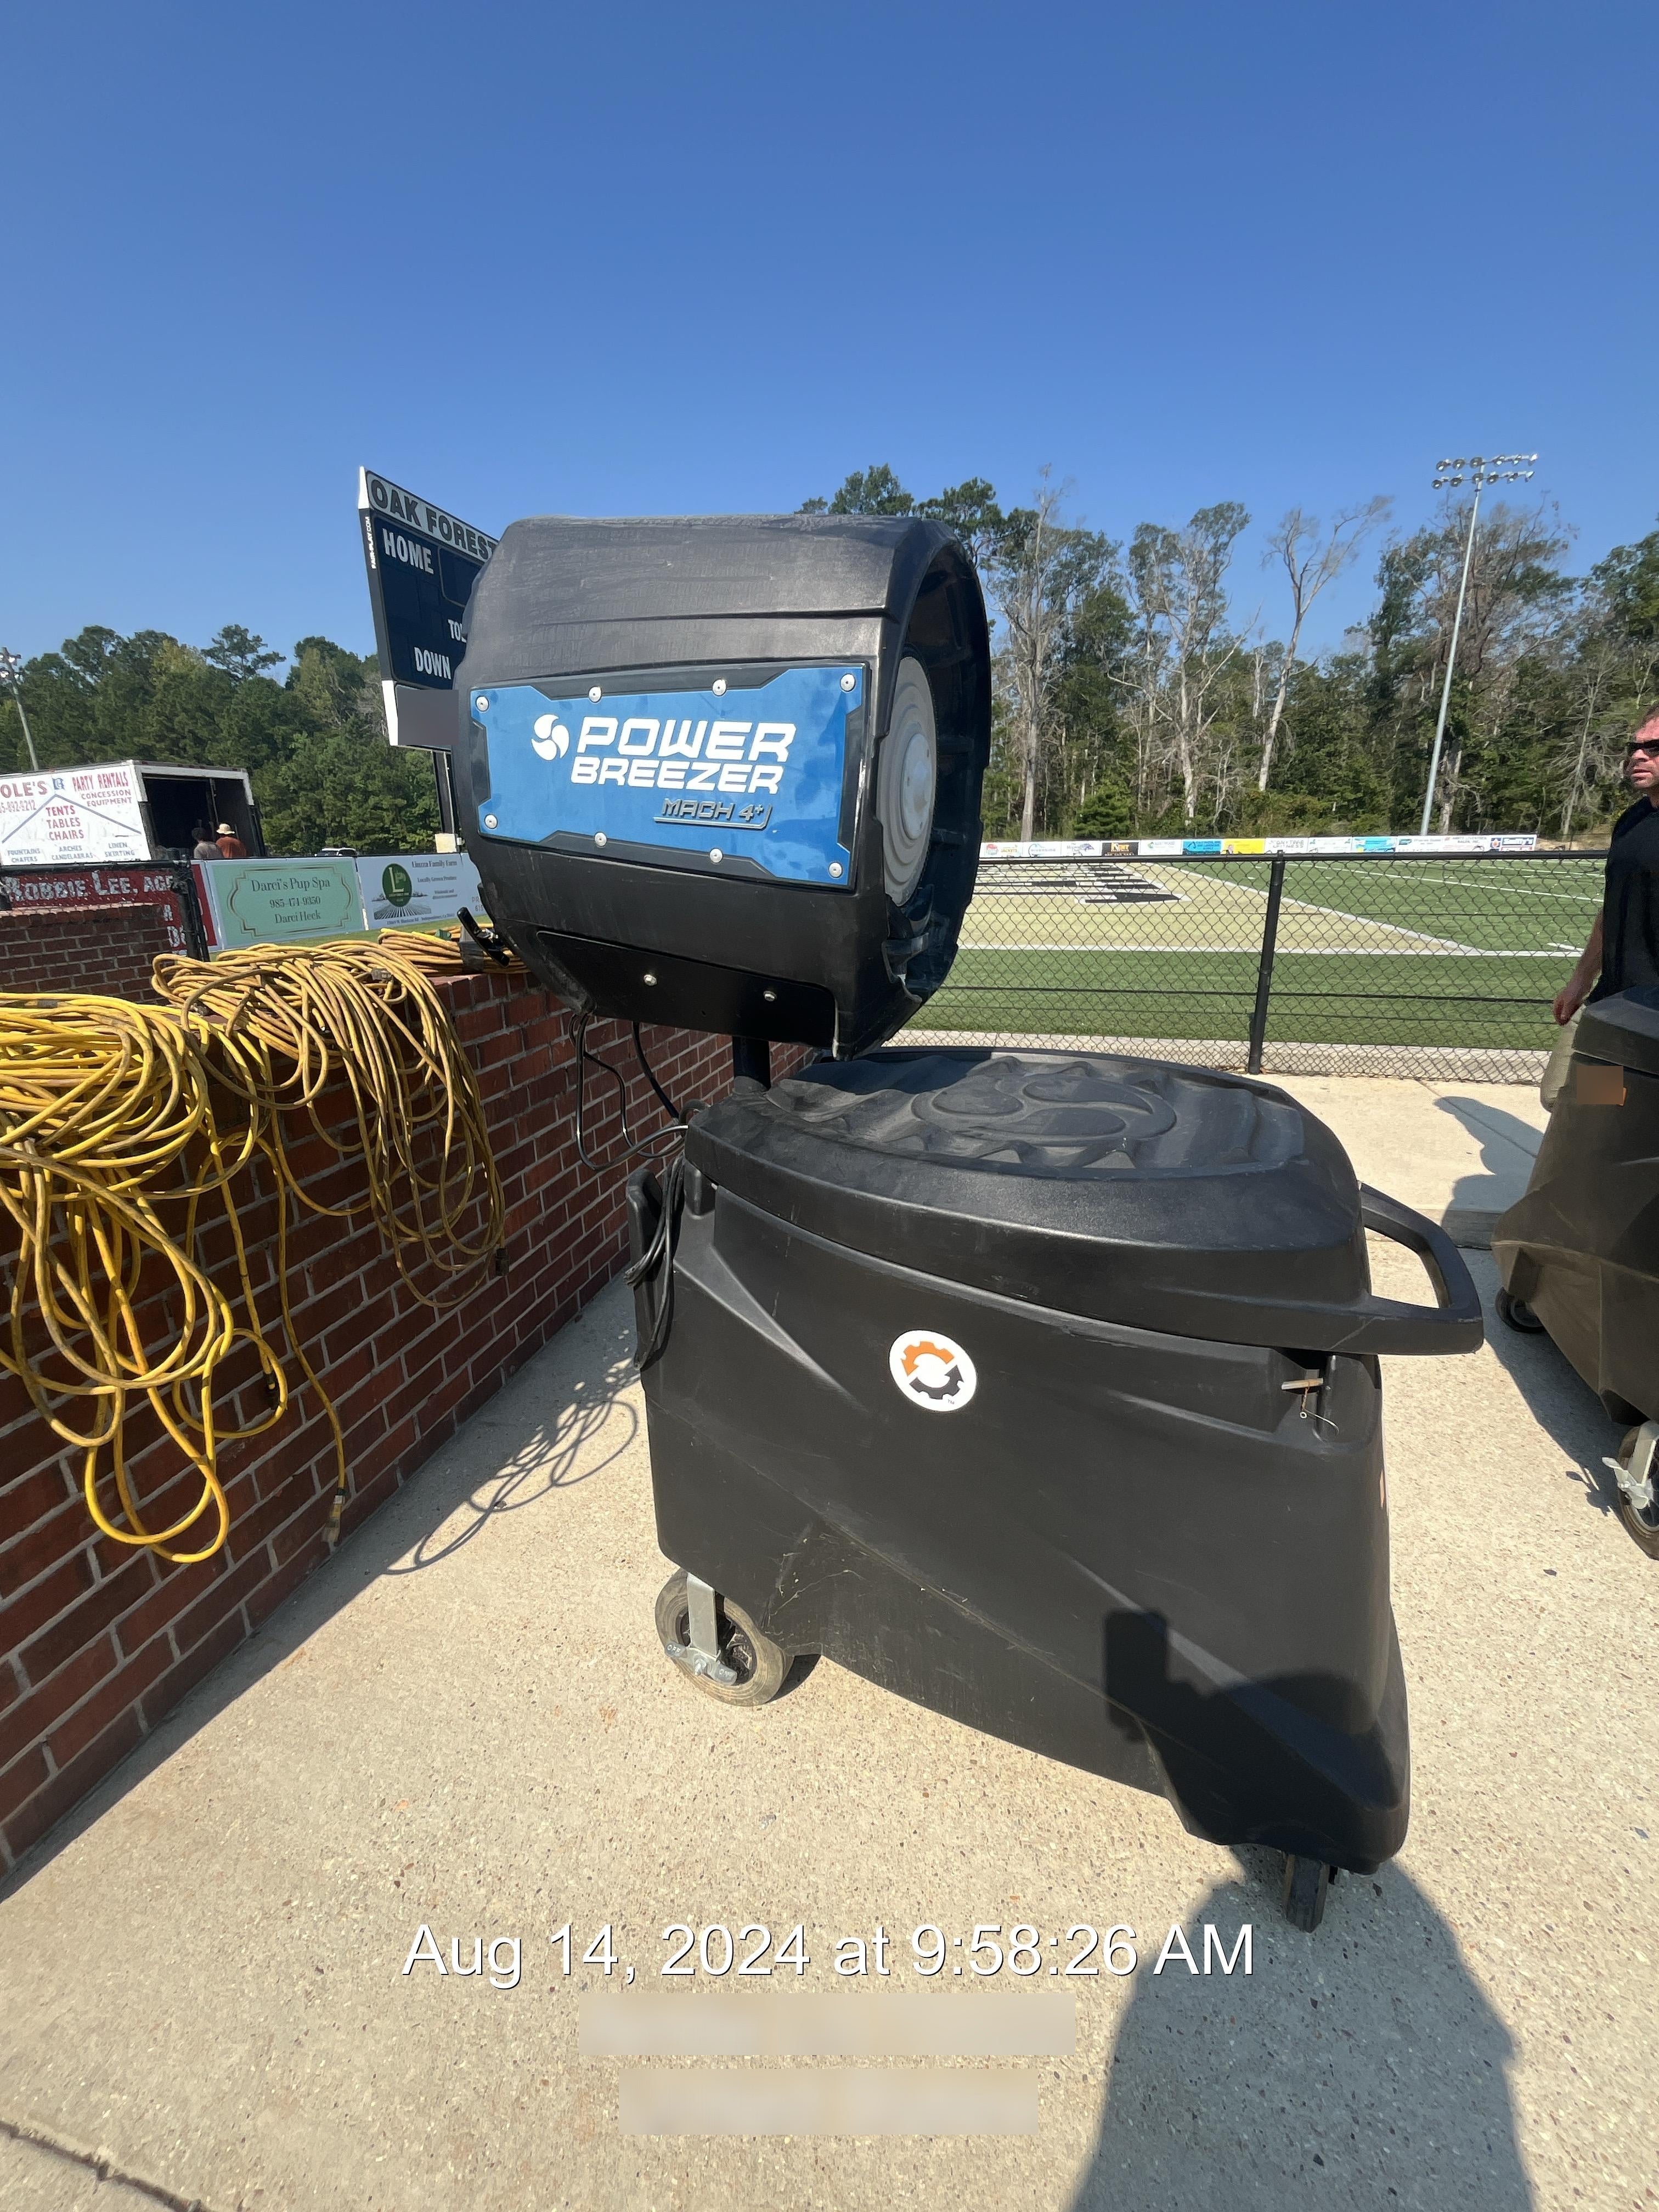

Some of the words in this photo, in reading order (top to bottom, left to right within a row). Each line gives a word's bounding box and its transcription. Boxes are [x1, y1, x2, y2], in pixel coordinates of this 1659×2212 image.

[371, 479, 421, 528] OAK
[382, 528, 433, 574] HOME
[414, 647, 451, 680] DOWN
[577, 716, 797, 762] POWER
[72, 775, 94, 792] PARTY
[97, 771, 128, 789] RENTALS
[571, 756, 785, 794] BREEZER
[81, 789, 131, 799] CONCESSION
[87, 797, 132, 806] EQUIPMENT
[46, 805, 76, 817] TENTS
[662, 798, 735, 821] MACH
[47, 817, 81, 828] TABLES
[49, 830, 84, 841] CHAIRS
[4, 876, 86, 902] ROBBIE
[252, 879, 289, 892] Darci's
[290, 877, 311, 891] Pup
[312, 877, 330, 890] Spa
[274, 912, 297, 924] Darci
